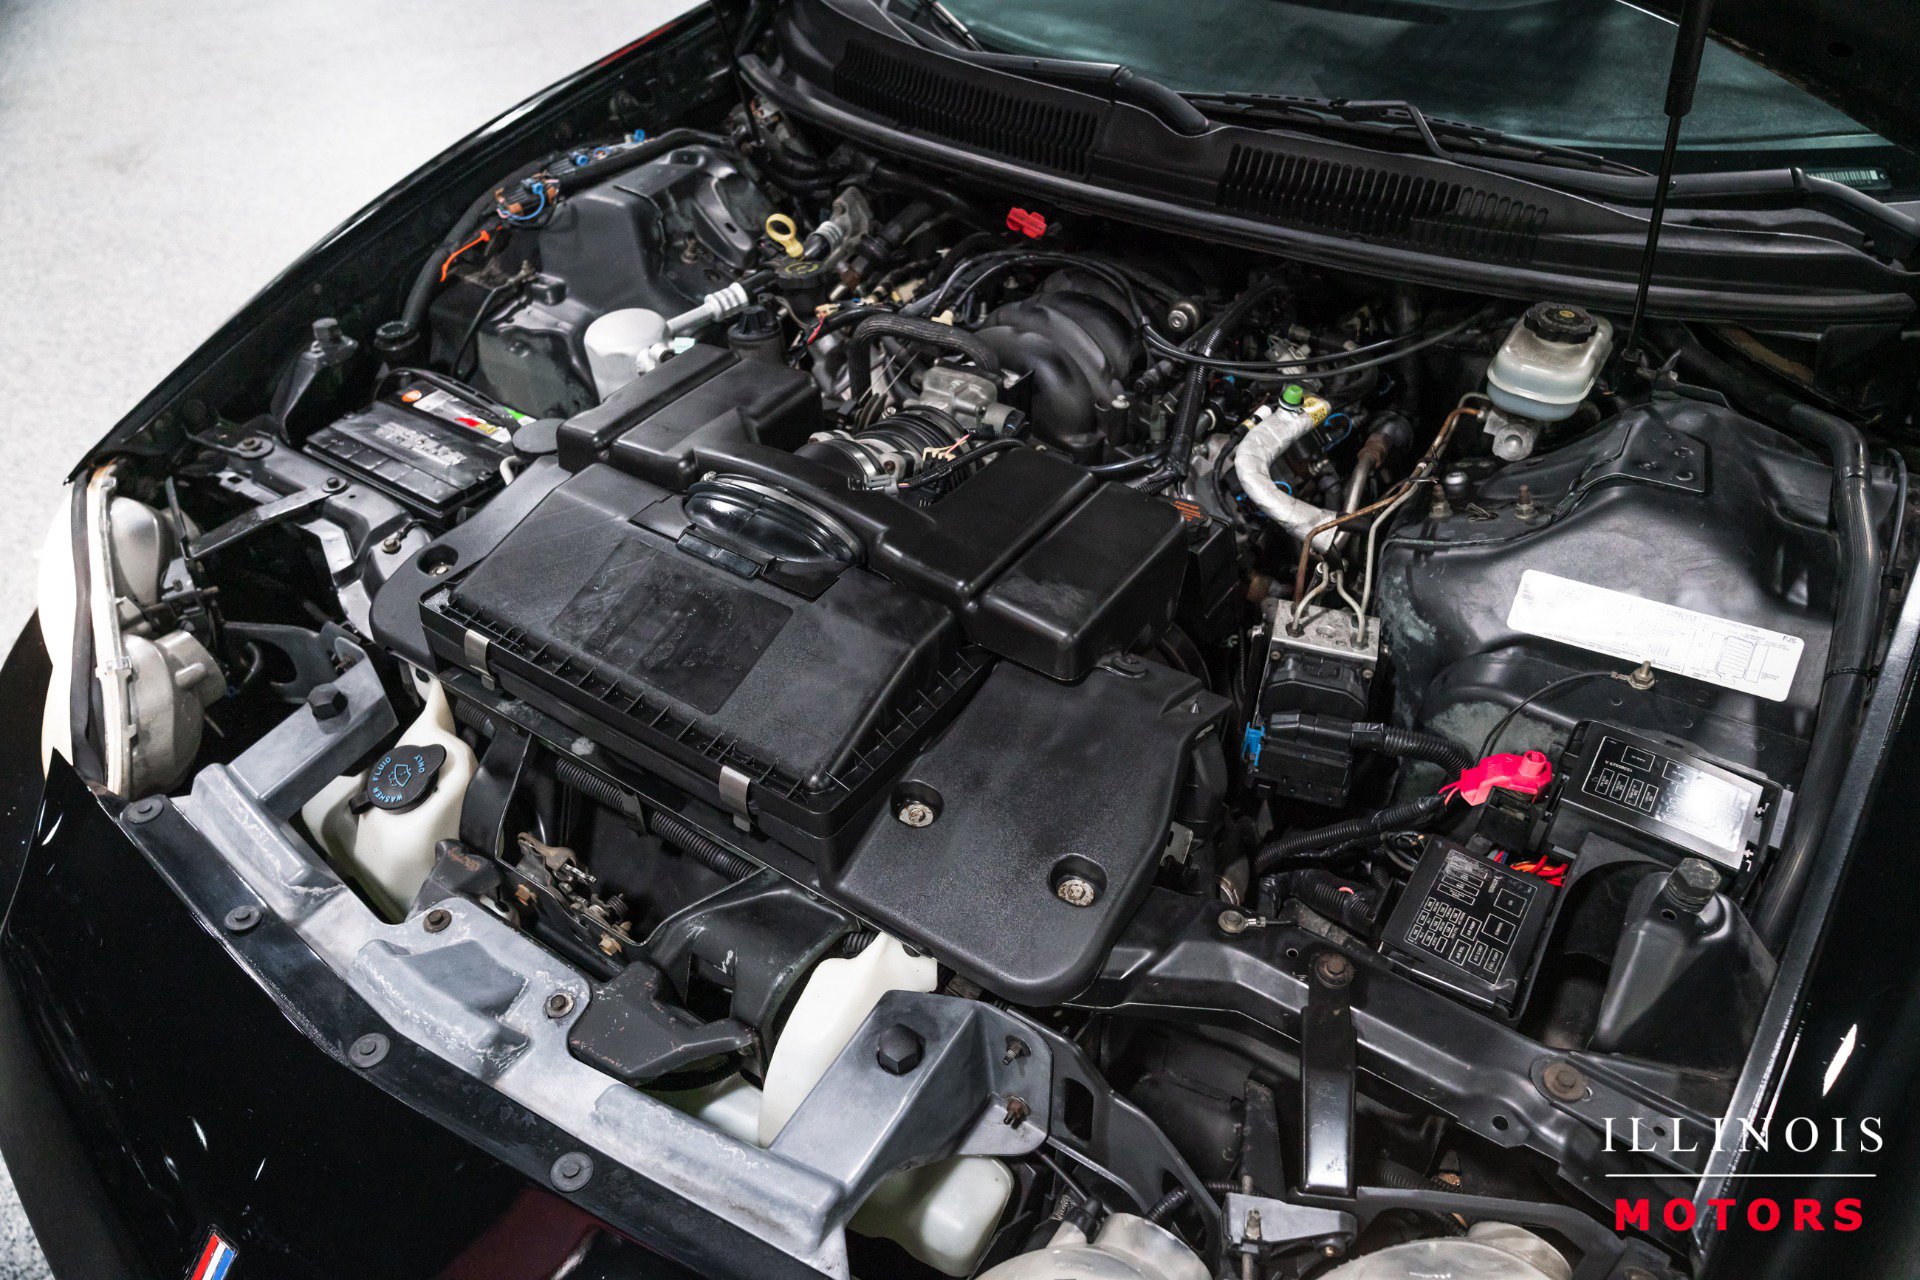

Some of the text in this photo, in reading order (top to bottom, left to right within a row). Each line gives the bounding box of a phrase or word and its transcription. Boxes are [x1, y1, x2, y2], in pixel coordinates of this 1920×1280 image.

[372, 756, 403, 803] WASHER FLUID
[414, 754, 426, 773] ONLY
